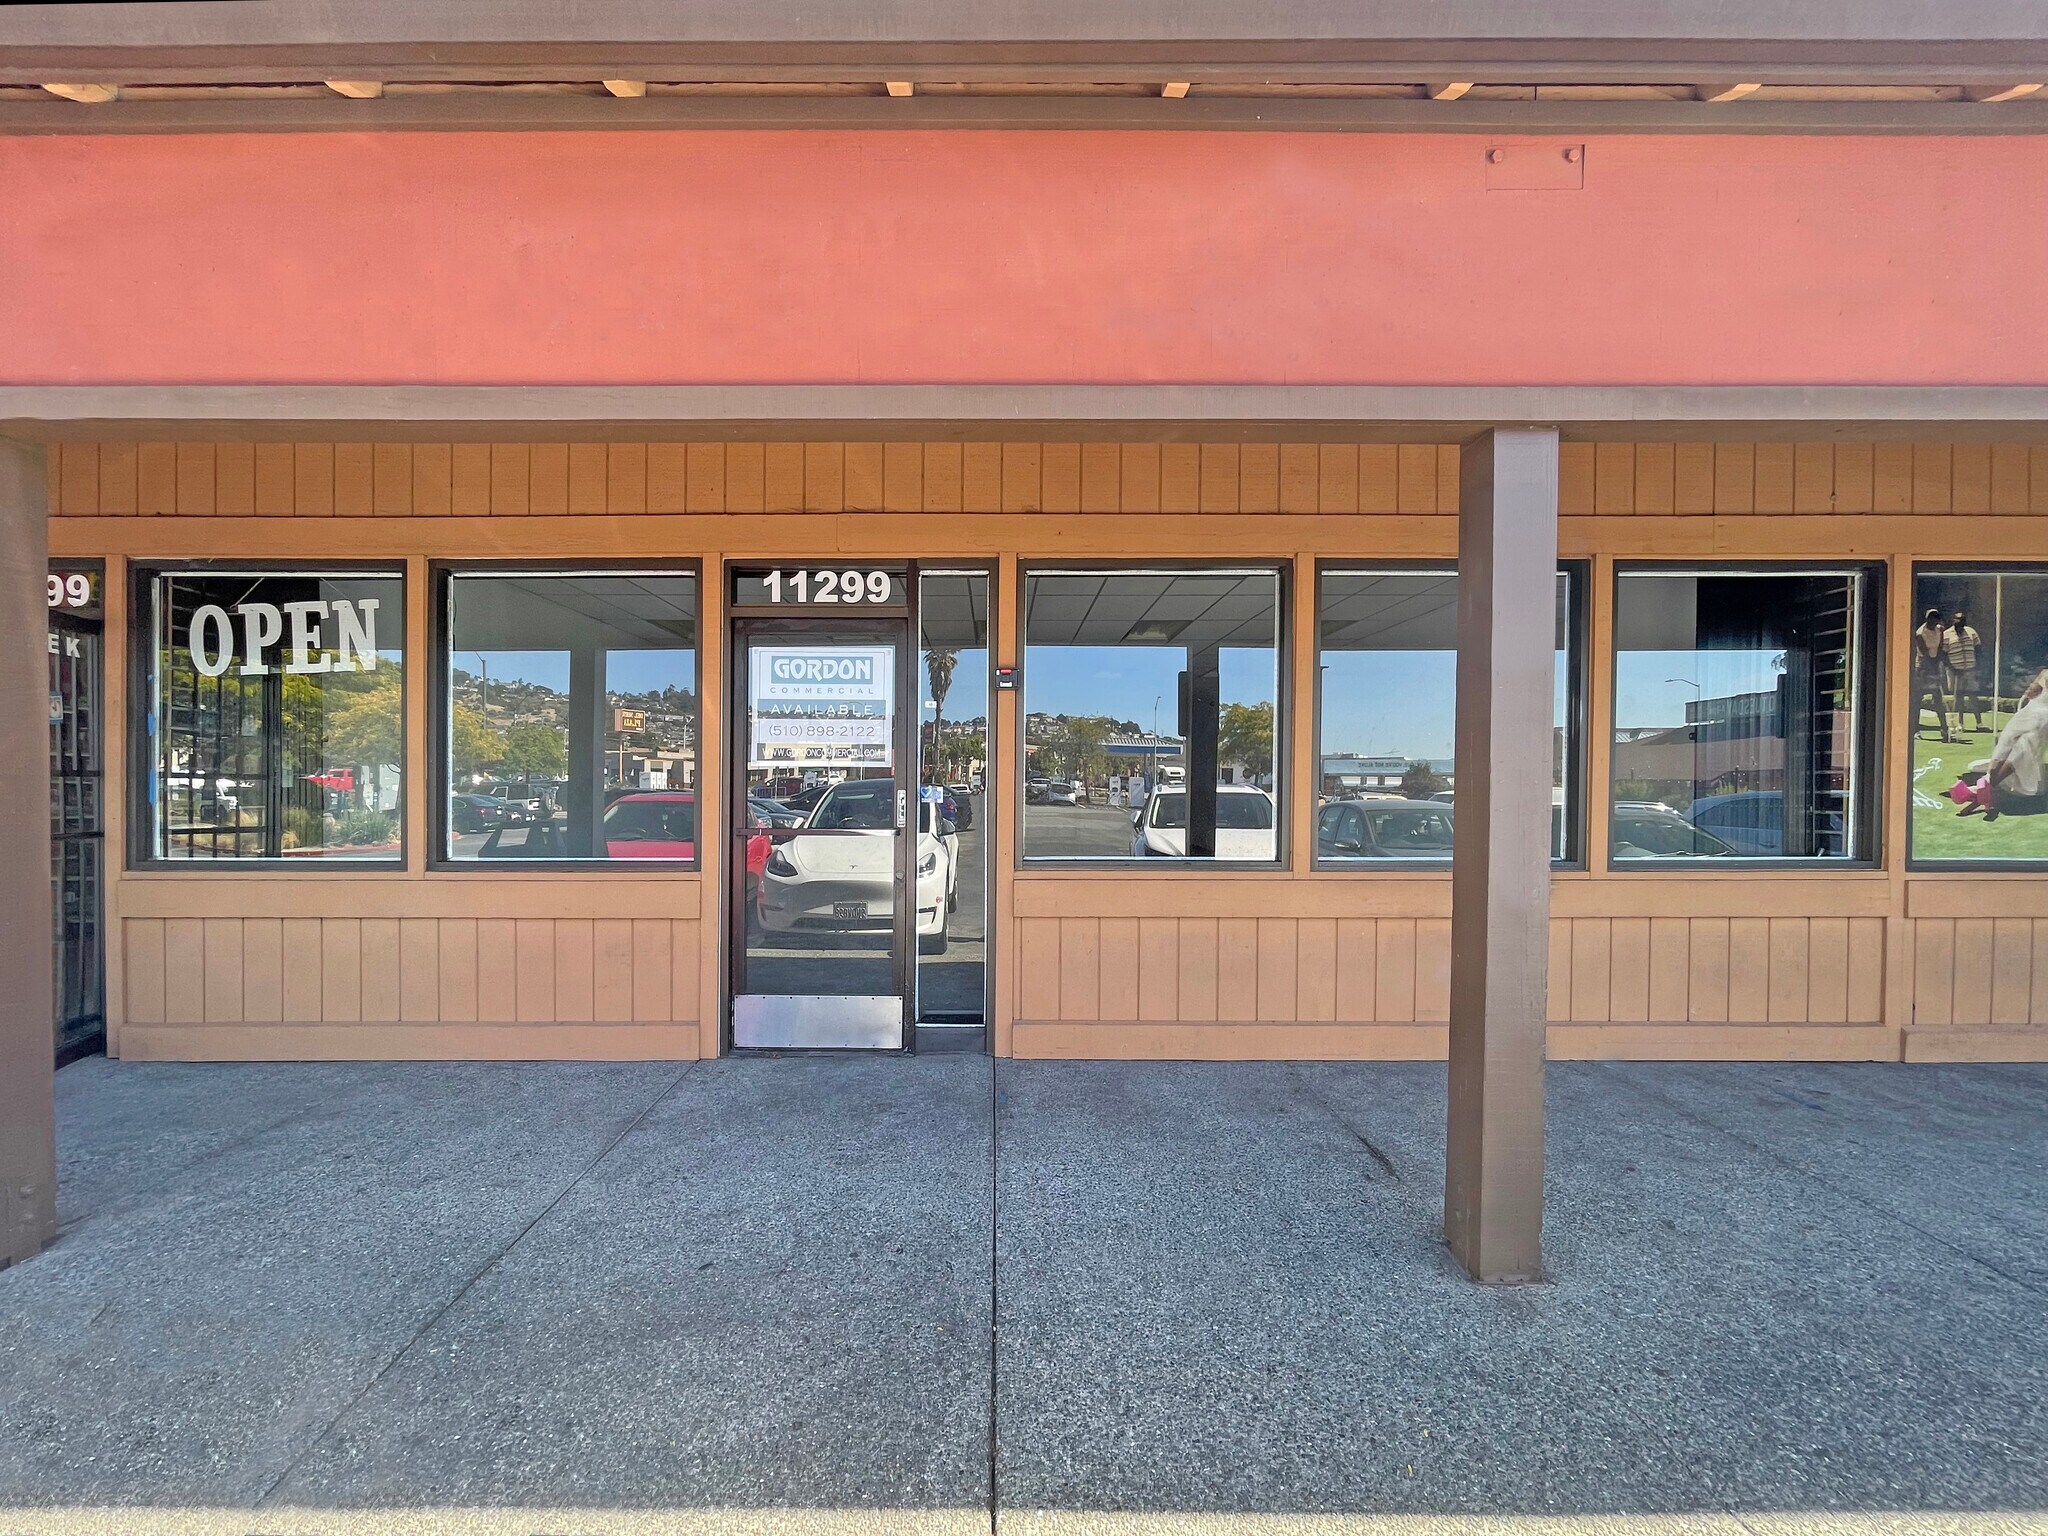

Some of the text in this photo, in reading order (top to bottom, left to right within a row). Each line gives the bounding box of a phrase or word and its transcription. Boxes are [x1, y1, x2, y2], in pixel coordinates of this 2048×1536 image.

[763, 570, 891, 604] 11299
[189, 598, 380, 677] OPEN
[774, 658, 871, 681] GORDON
[770, 704, 874, 715] AVAILABLE
[769, 725, 875, 737] (510) 898-2122
